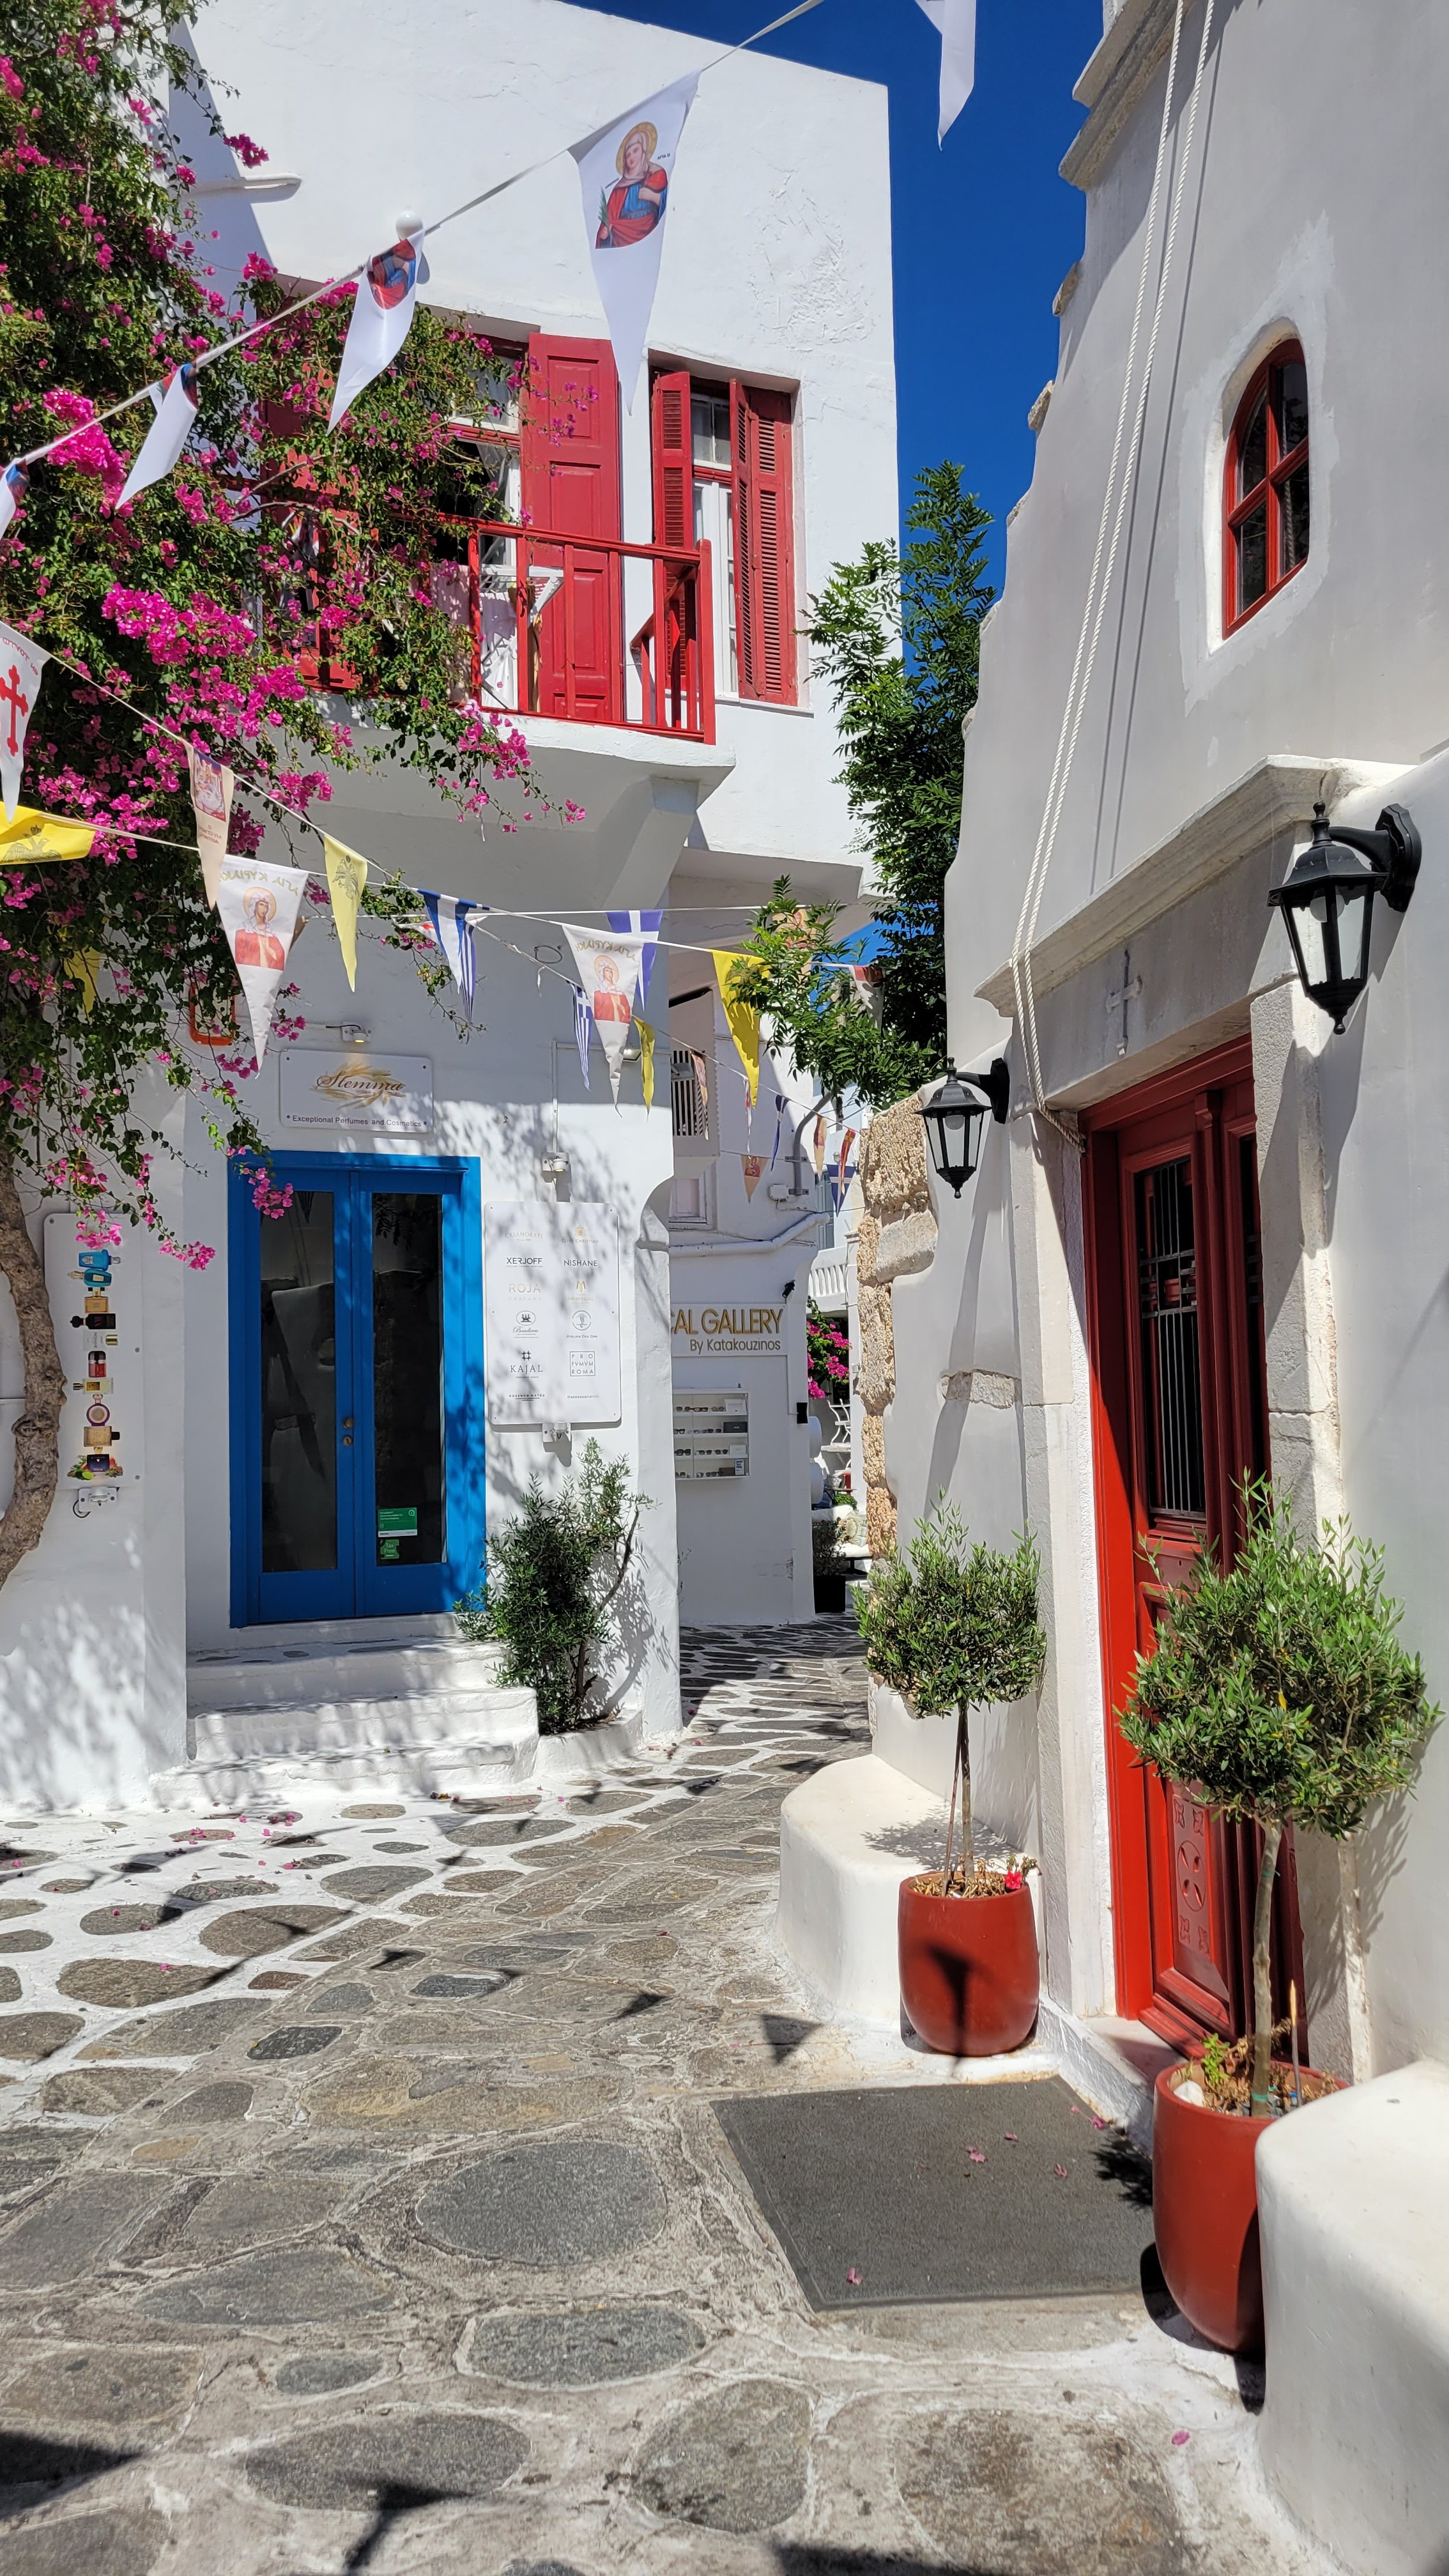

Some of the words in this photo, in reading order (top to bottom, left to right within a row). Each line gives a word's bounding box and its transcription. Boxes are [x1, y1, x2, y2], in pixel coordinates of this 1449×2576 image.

[316, 1071, 402, 1091] Stemma
[293, 1115, 334, 1123] Exceptional
[507, 1257, 543, 1265] XERJOFF
[509, 1284, 541, 1293] ROJA
[701, 1308, 783, 1335] GALLERY
[690, 1339, 703, 1354] By
[707, 1337, 781, 1351] Katakouzinos
[510, 1365, 543, 1374] KAJAL
